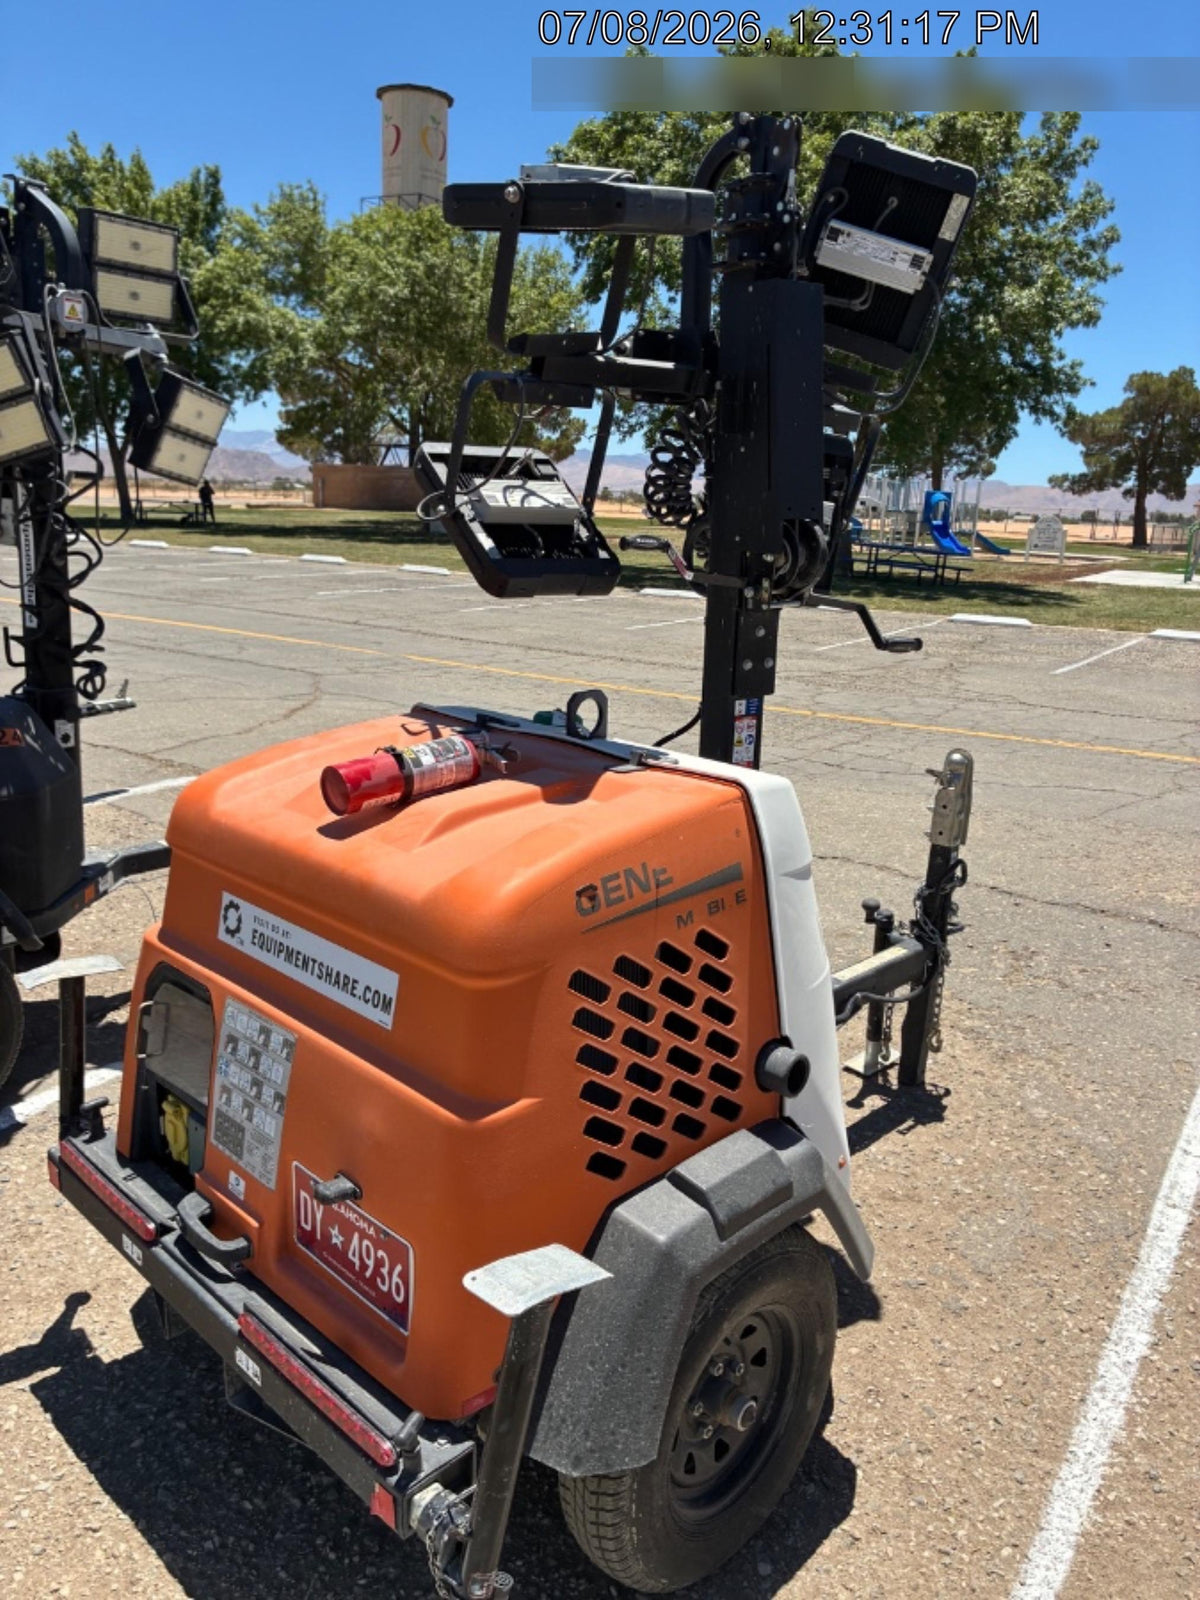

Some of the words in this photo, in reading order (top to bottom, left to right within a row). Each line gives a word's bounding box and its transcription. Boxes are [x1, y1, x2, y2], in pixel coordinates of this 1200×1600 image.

[250, 928, 394, 1016] EQUIPMENTSHARE.COM
[300, 1189, 324, 1241] DY
[348, 1231, 405, 1304] 4936
